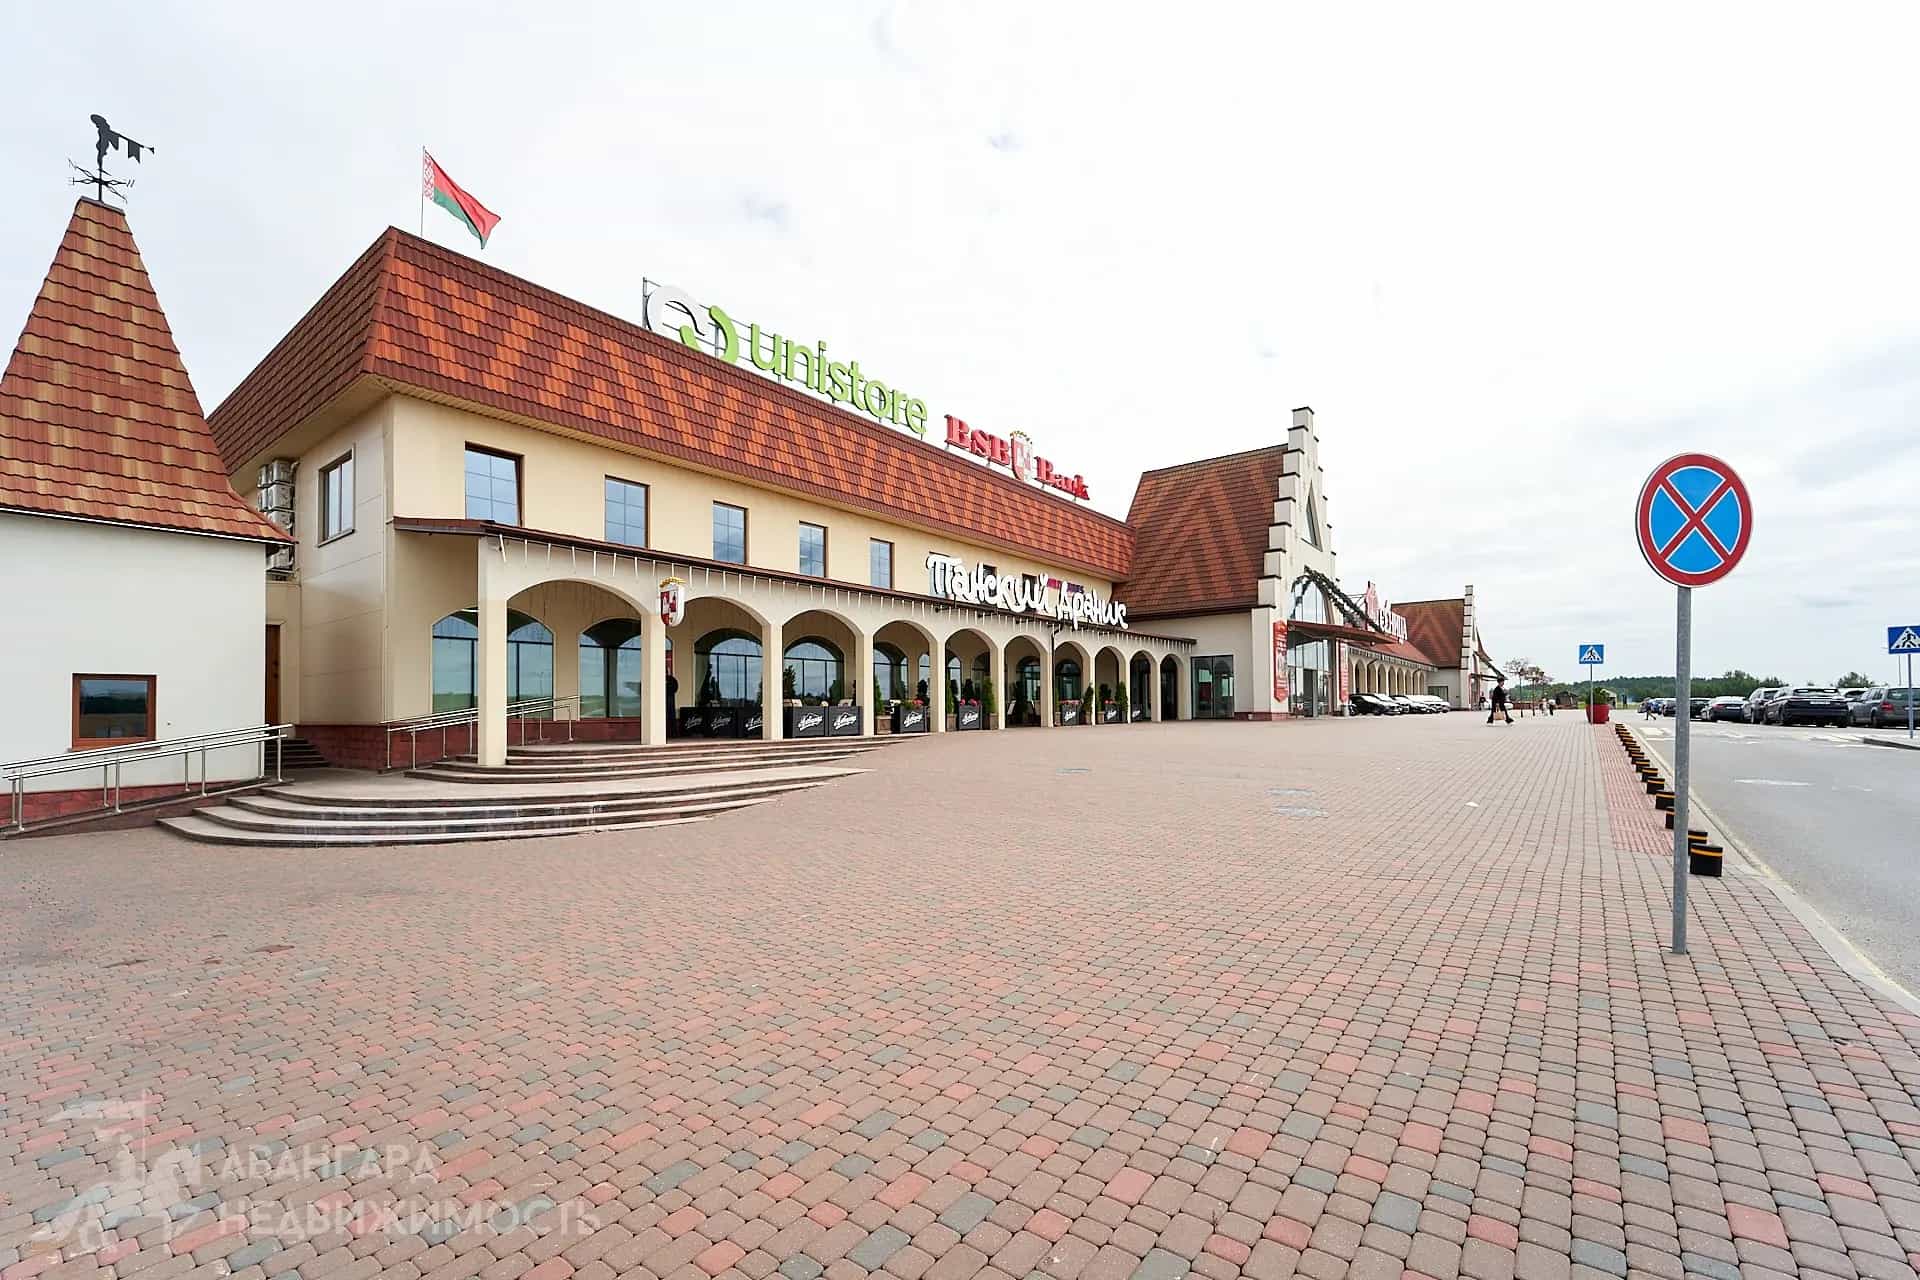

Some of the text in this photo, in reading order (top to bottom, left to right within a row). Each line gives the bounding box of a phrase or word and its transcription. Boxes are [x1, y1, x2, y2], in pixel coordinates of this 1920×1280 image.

[750, 323, 928, 434] unistore
[944, 414, 1091, 501] BSB Bank
[926, 554, 1053, 614] Панский
